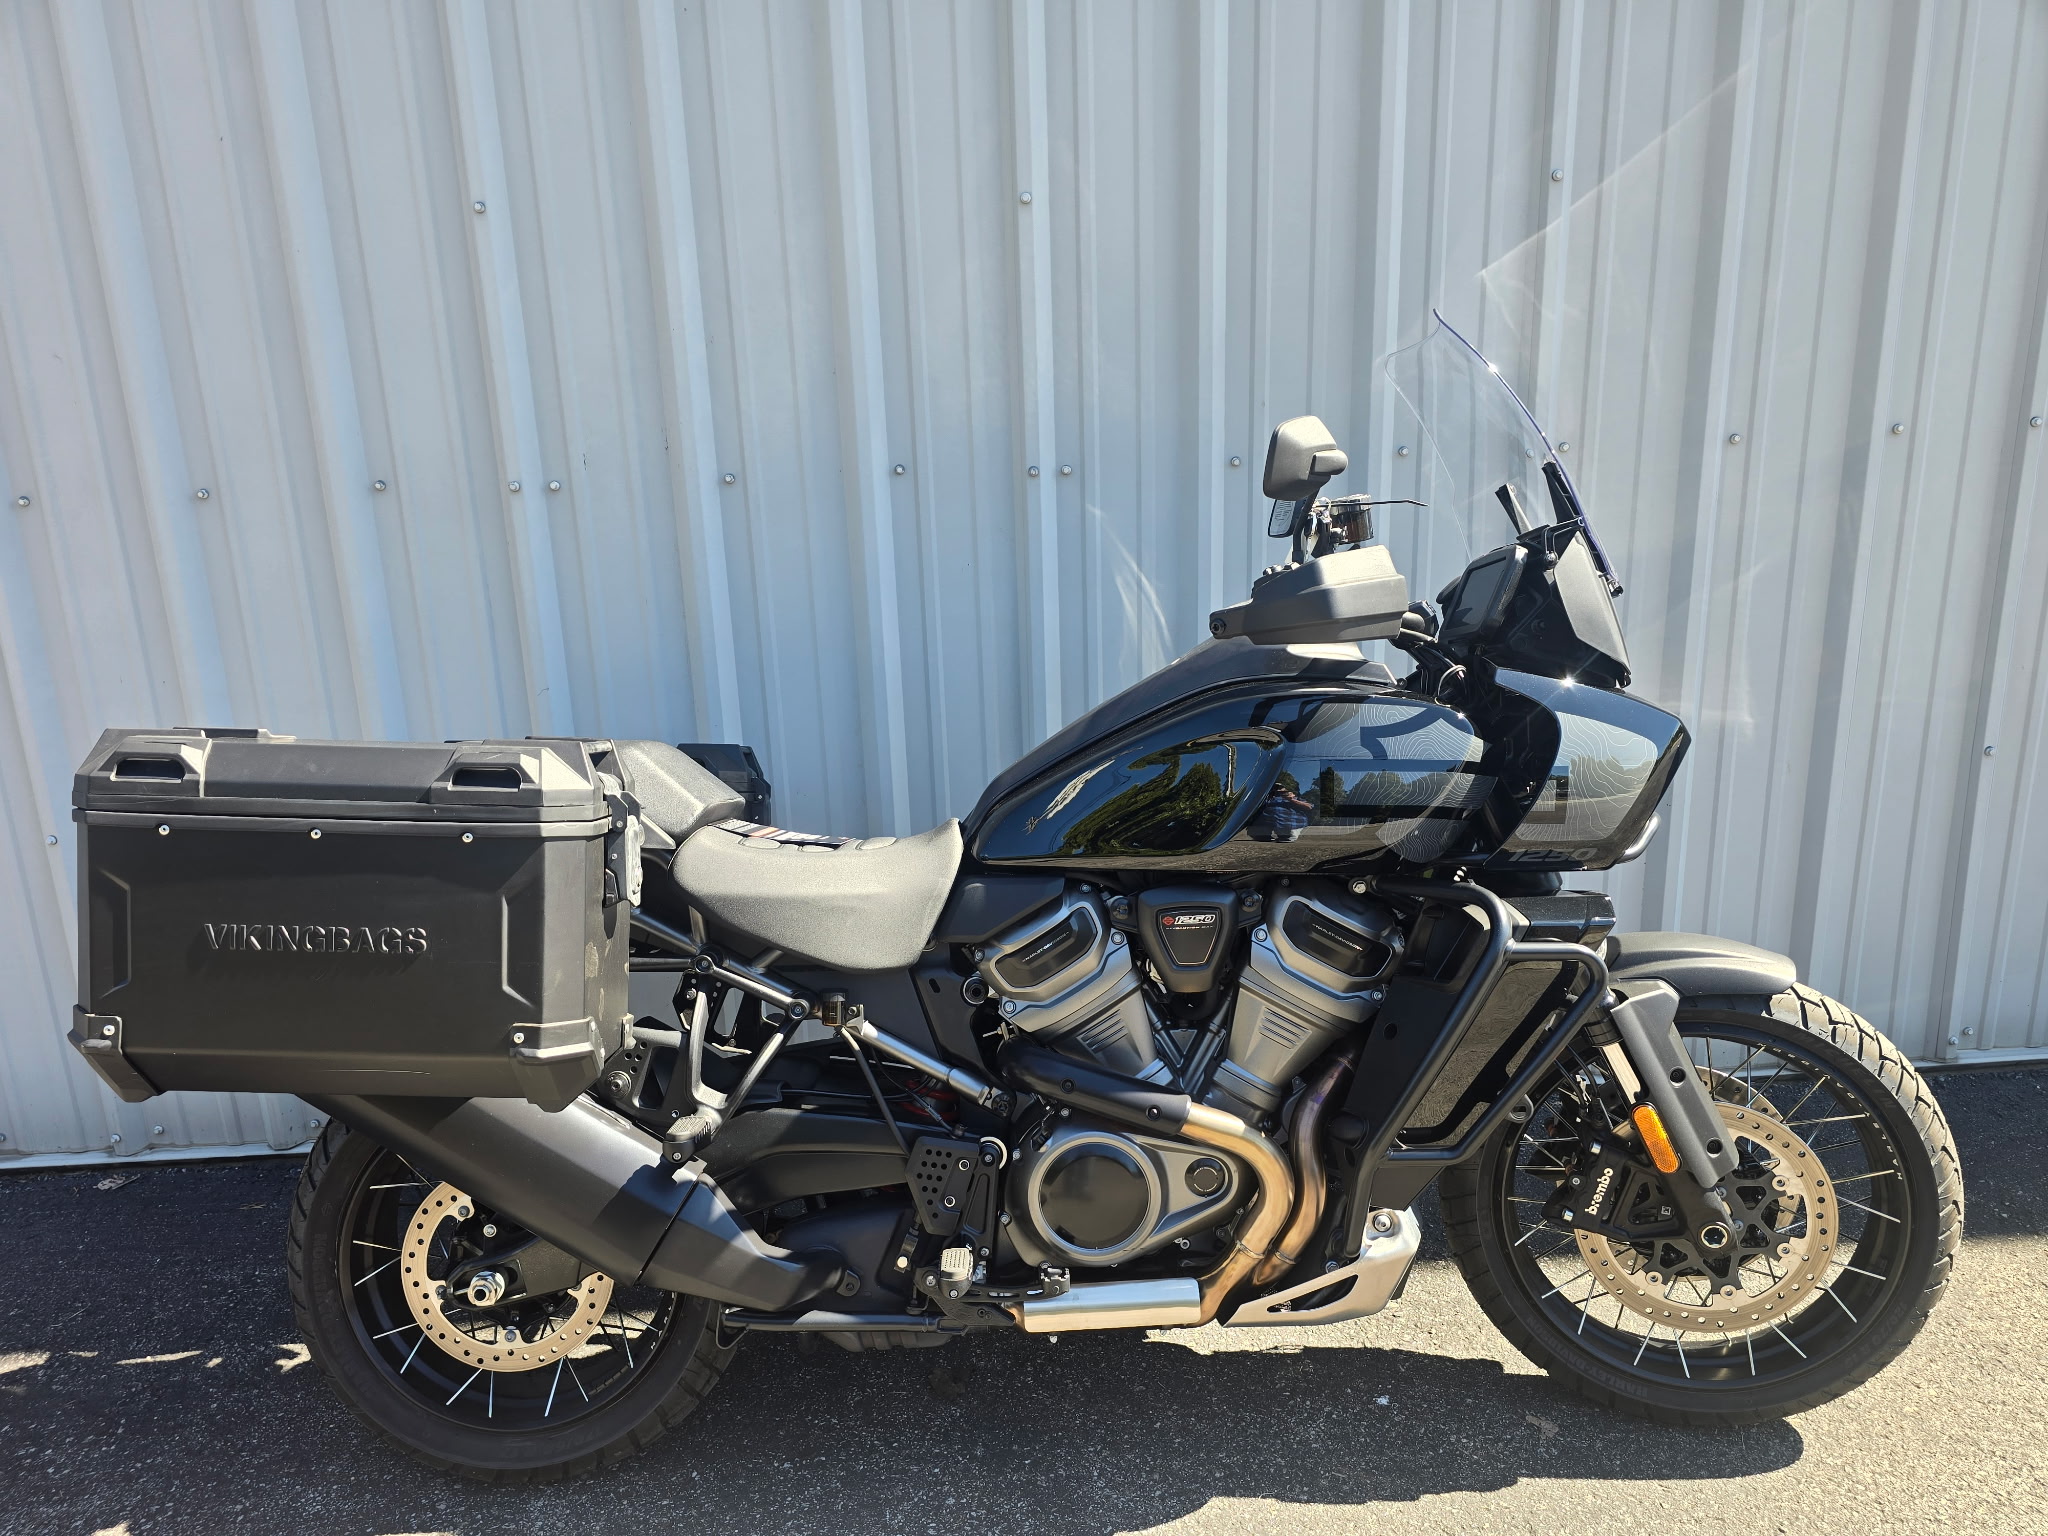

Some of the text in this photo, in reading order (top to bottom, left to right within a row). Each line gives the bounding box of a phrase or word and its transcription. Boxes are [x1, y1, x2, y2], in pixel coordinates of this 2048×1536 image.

[1508, 847, 1600, 863] 1250
[1174, 914, 1216, 925] 1250
[204, 923, 428, 955] VIKINGBAGS
[1584, 1167, 1614, 1216] brembo
